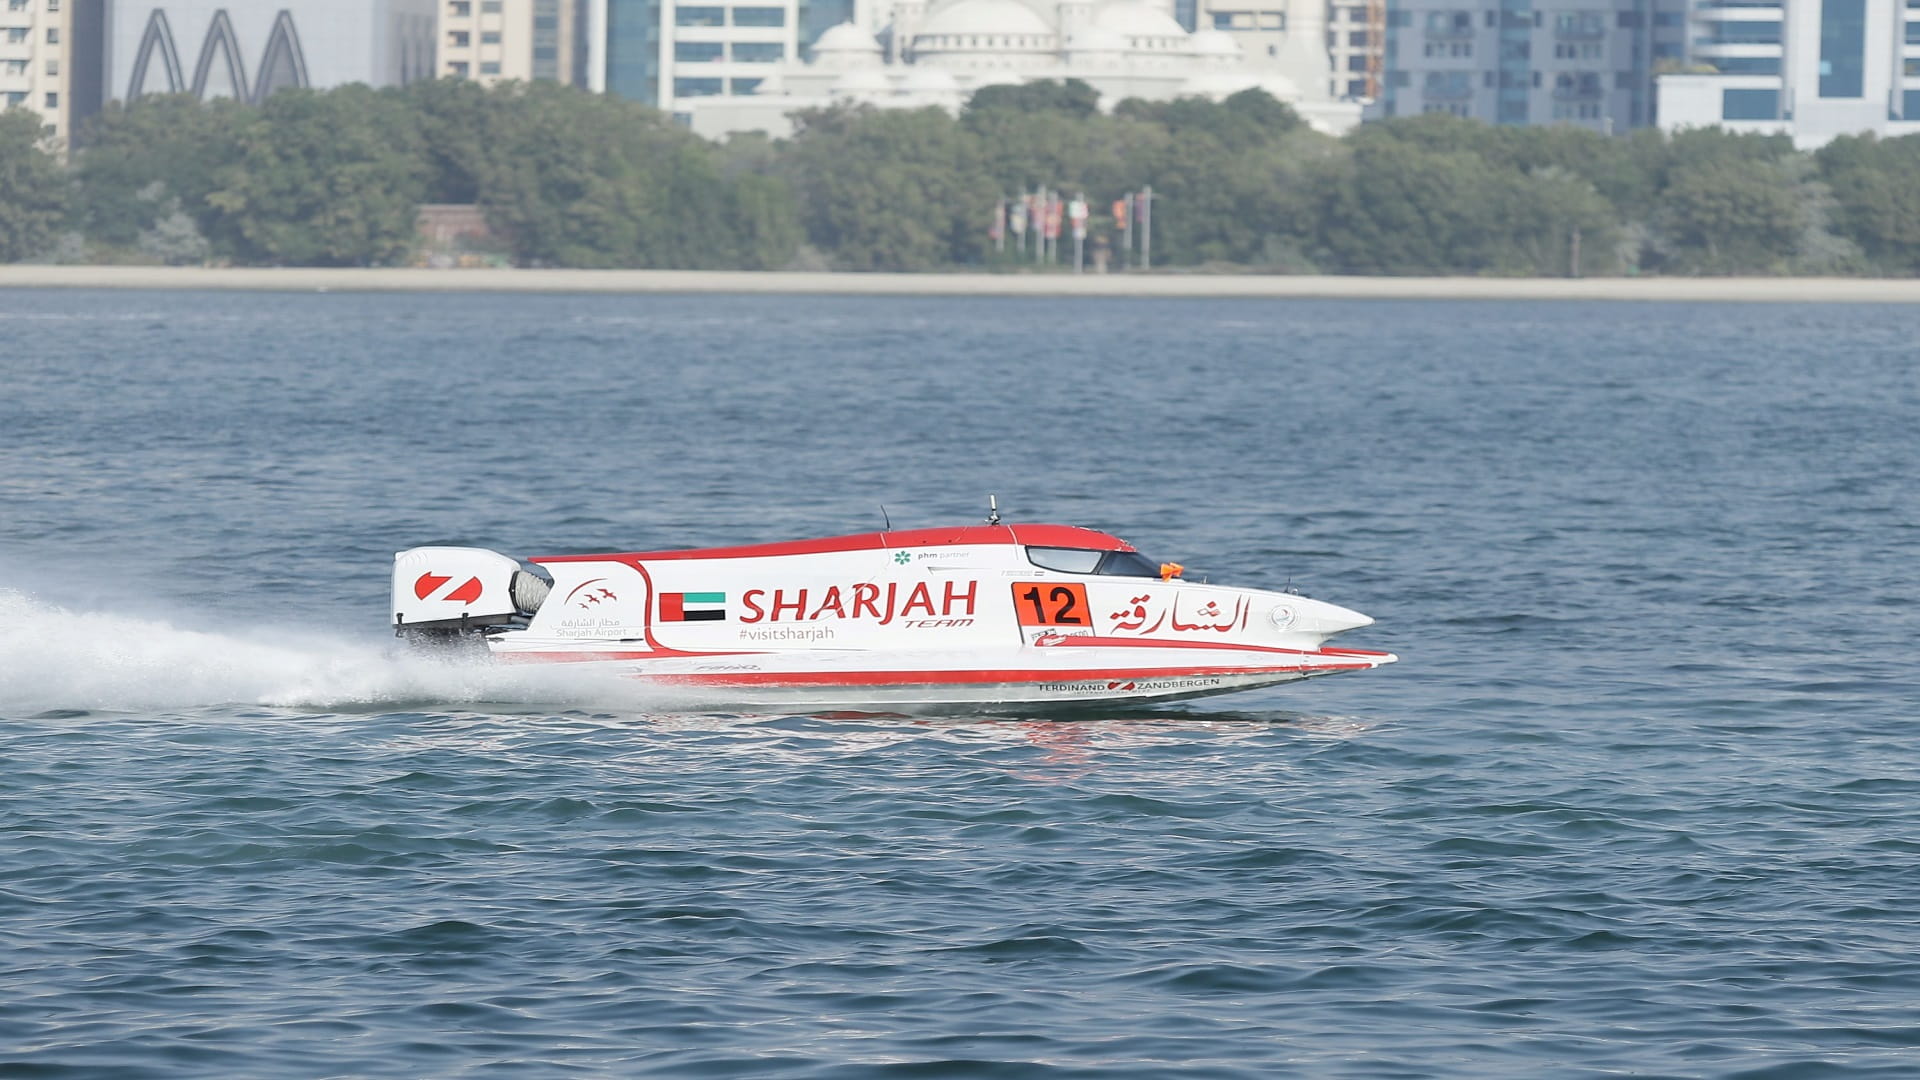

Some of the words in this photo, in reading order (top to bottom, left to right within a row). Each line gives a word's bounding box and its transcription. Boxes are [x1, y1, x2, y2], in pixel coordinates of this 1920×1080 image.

[918, 552, 938, 560] phm
[739, 580, 978, 625] SHARJAH
[1023, 587, 1081, 624] 12
[1109, 591, 1251, 635] الشارقة
[905, 618, 975, 628] TEAM
[556, 628, 592, 637] Sharjah
[594, 627, 627, 637] Airport
[739, 626, 835, 641] #visitsharjah
[1039, 683, 1105, 693] FERDINAND
[1137, 679, 1220, 690] ZANDBERGEN
